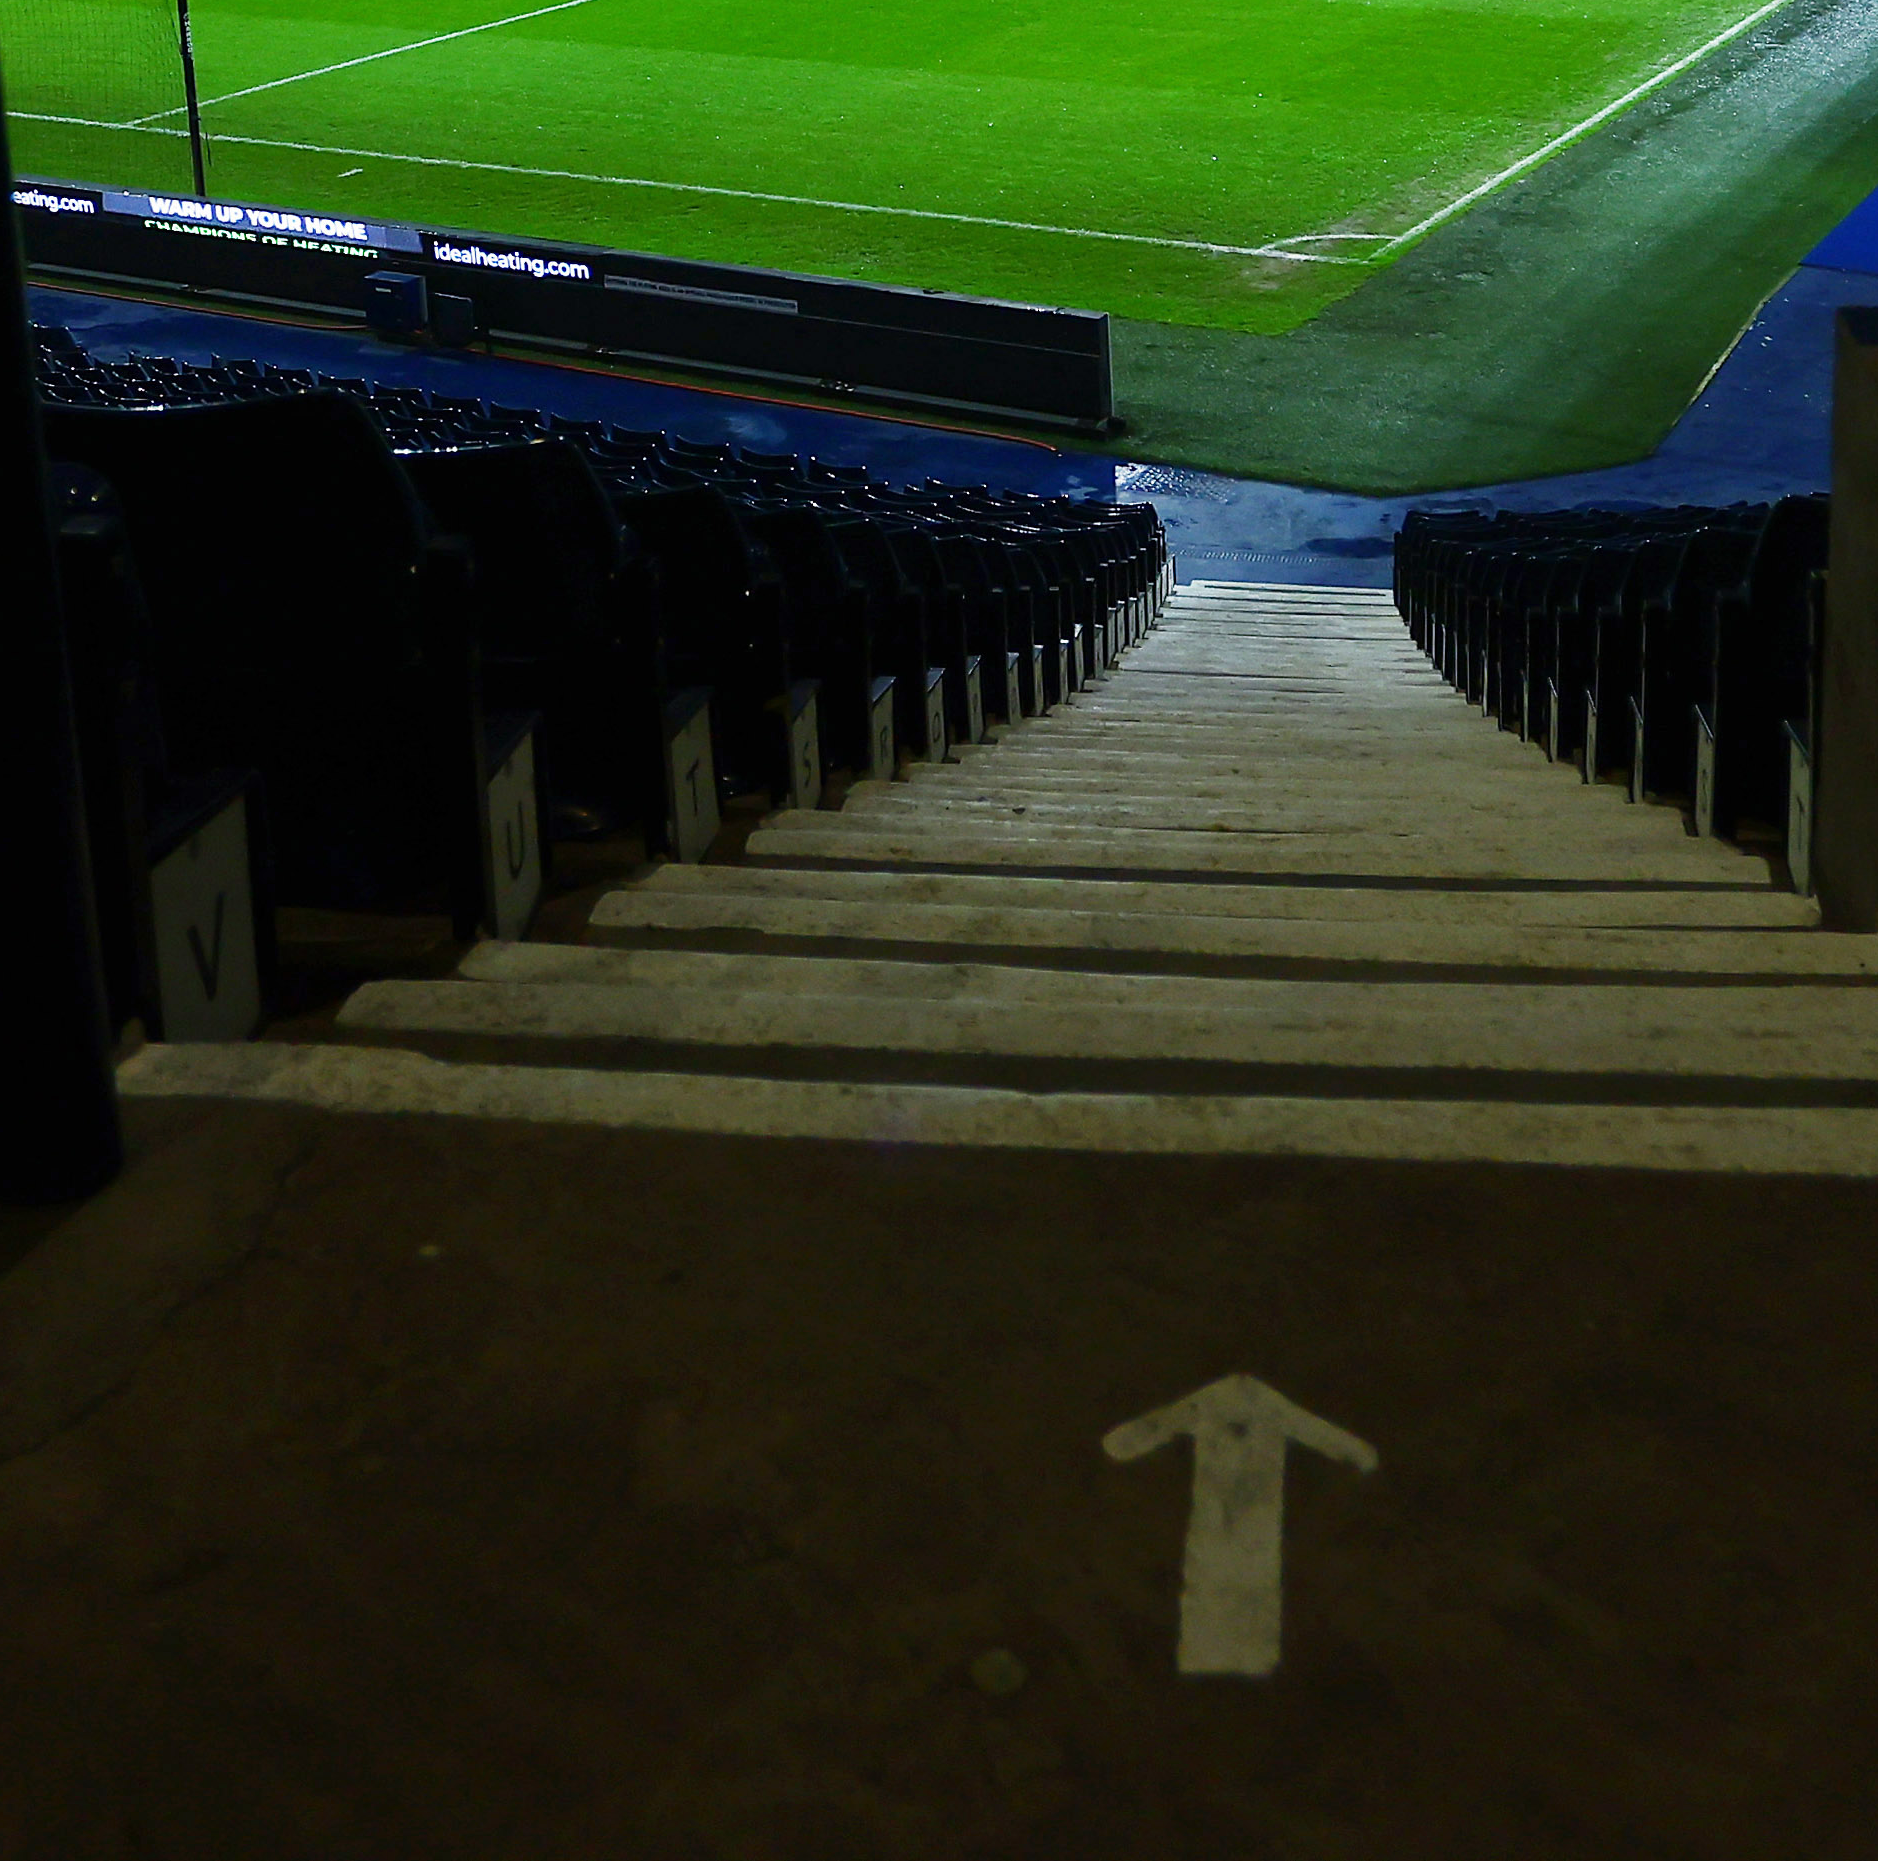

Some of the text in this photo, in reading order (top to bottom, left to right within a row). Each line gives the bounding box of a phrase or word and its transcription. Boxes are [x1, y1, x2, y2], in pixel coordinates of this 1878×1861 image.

[13, 189, 95, 214] eating.com
[149, 196, 368, 241] WARM UP YOUR HOME
[143, 219, 257, 242] CHAMPIONS
[293, 239, 379, 259] HEATING
[432, 241, 591, 280] idealheating.com
[506, 799, 526, 882] U
[186, 890, 229, 1001] V
